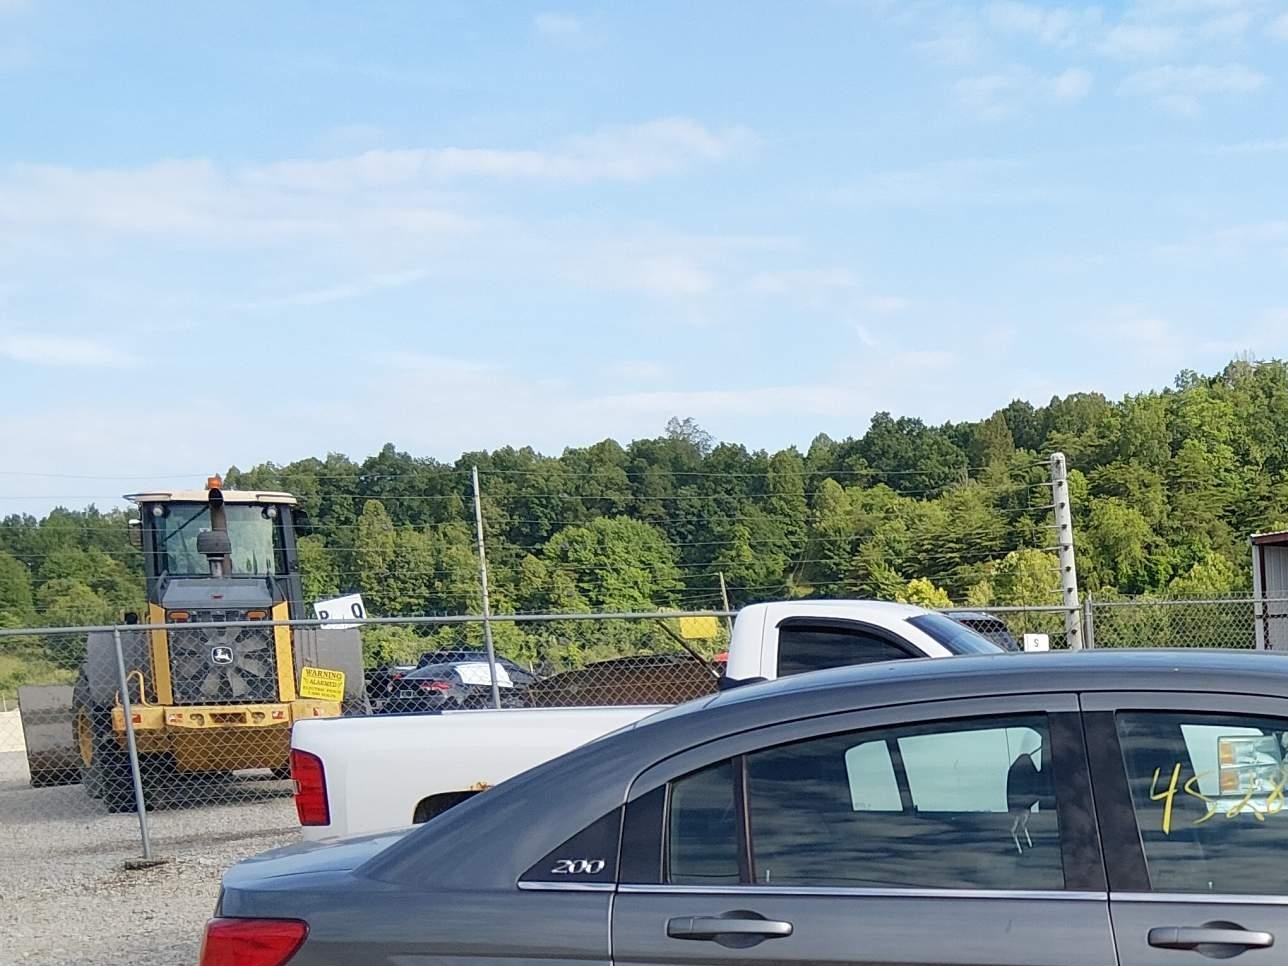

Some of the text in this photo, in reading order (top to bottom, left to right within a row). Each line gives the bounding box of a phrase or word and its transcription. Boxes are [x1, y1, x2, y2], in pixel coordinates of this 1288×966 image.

[351, 603, 363, 619] Q
[305, 669, 343, 680] WARNING
[551, 859, 605, 874] 200
